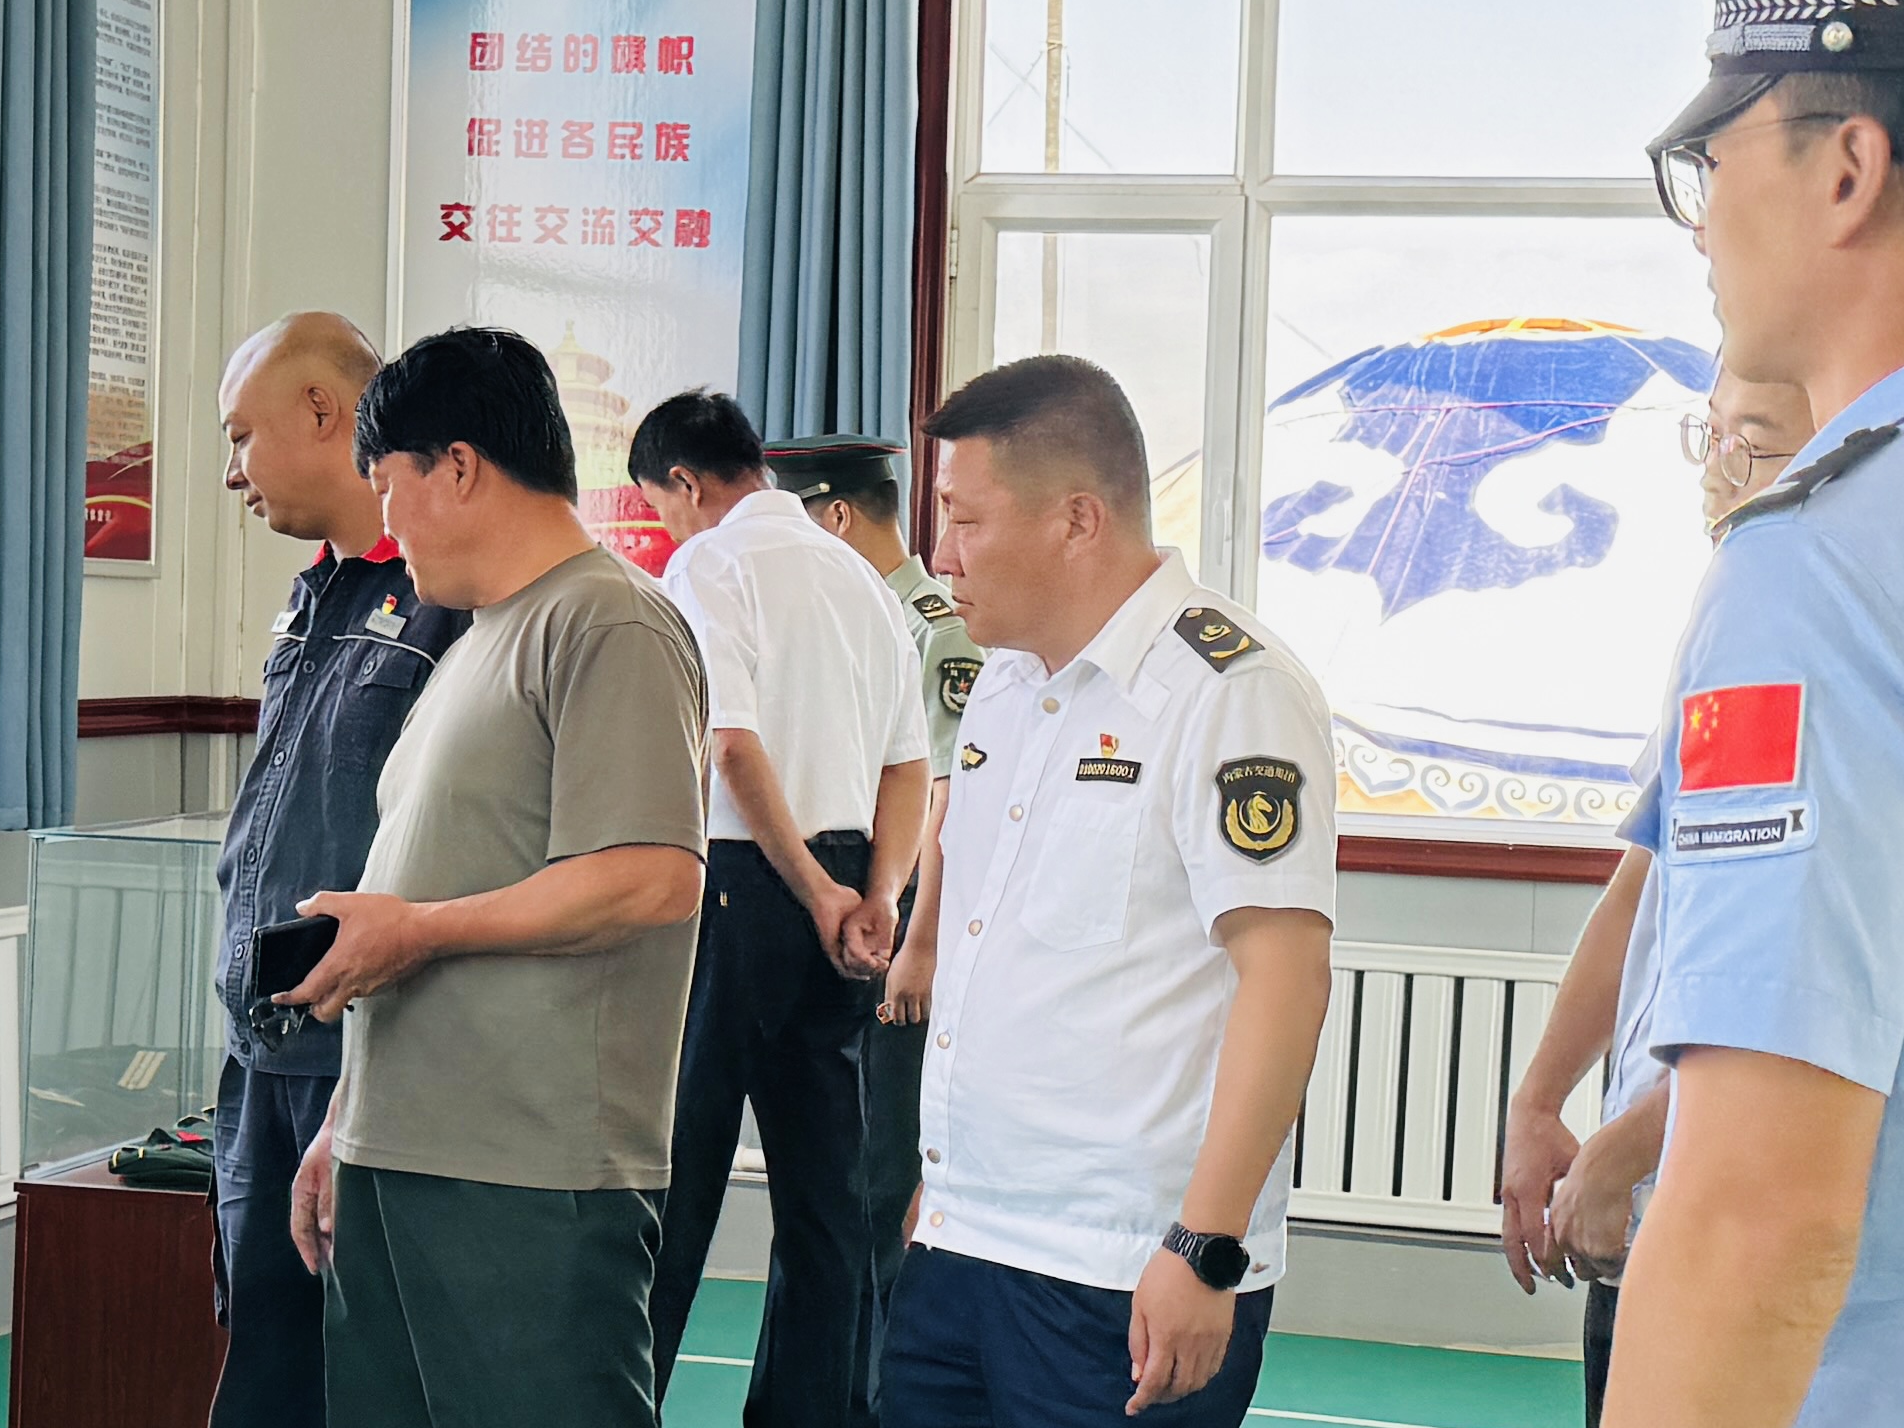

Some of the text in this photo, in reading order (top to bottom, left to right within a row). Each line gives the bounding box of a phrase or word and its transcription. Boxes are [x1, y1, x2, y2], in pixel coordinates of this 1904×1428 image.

[467, 32, 695, 76] 团结的旗帜
[466, 117, 691, 162] 促进各民族
[438, 201, 712, 249] 交往交流交融
